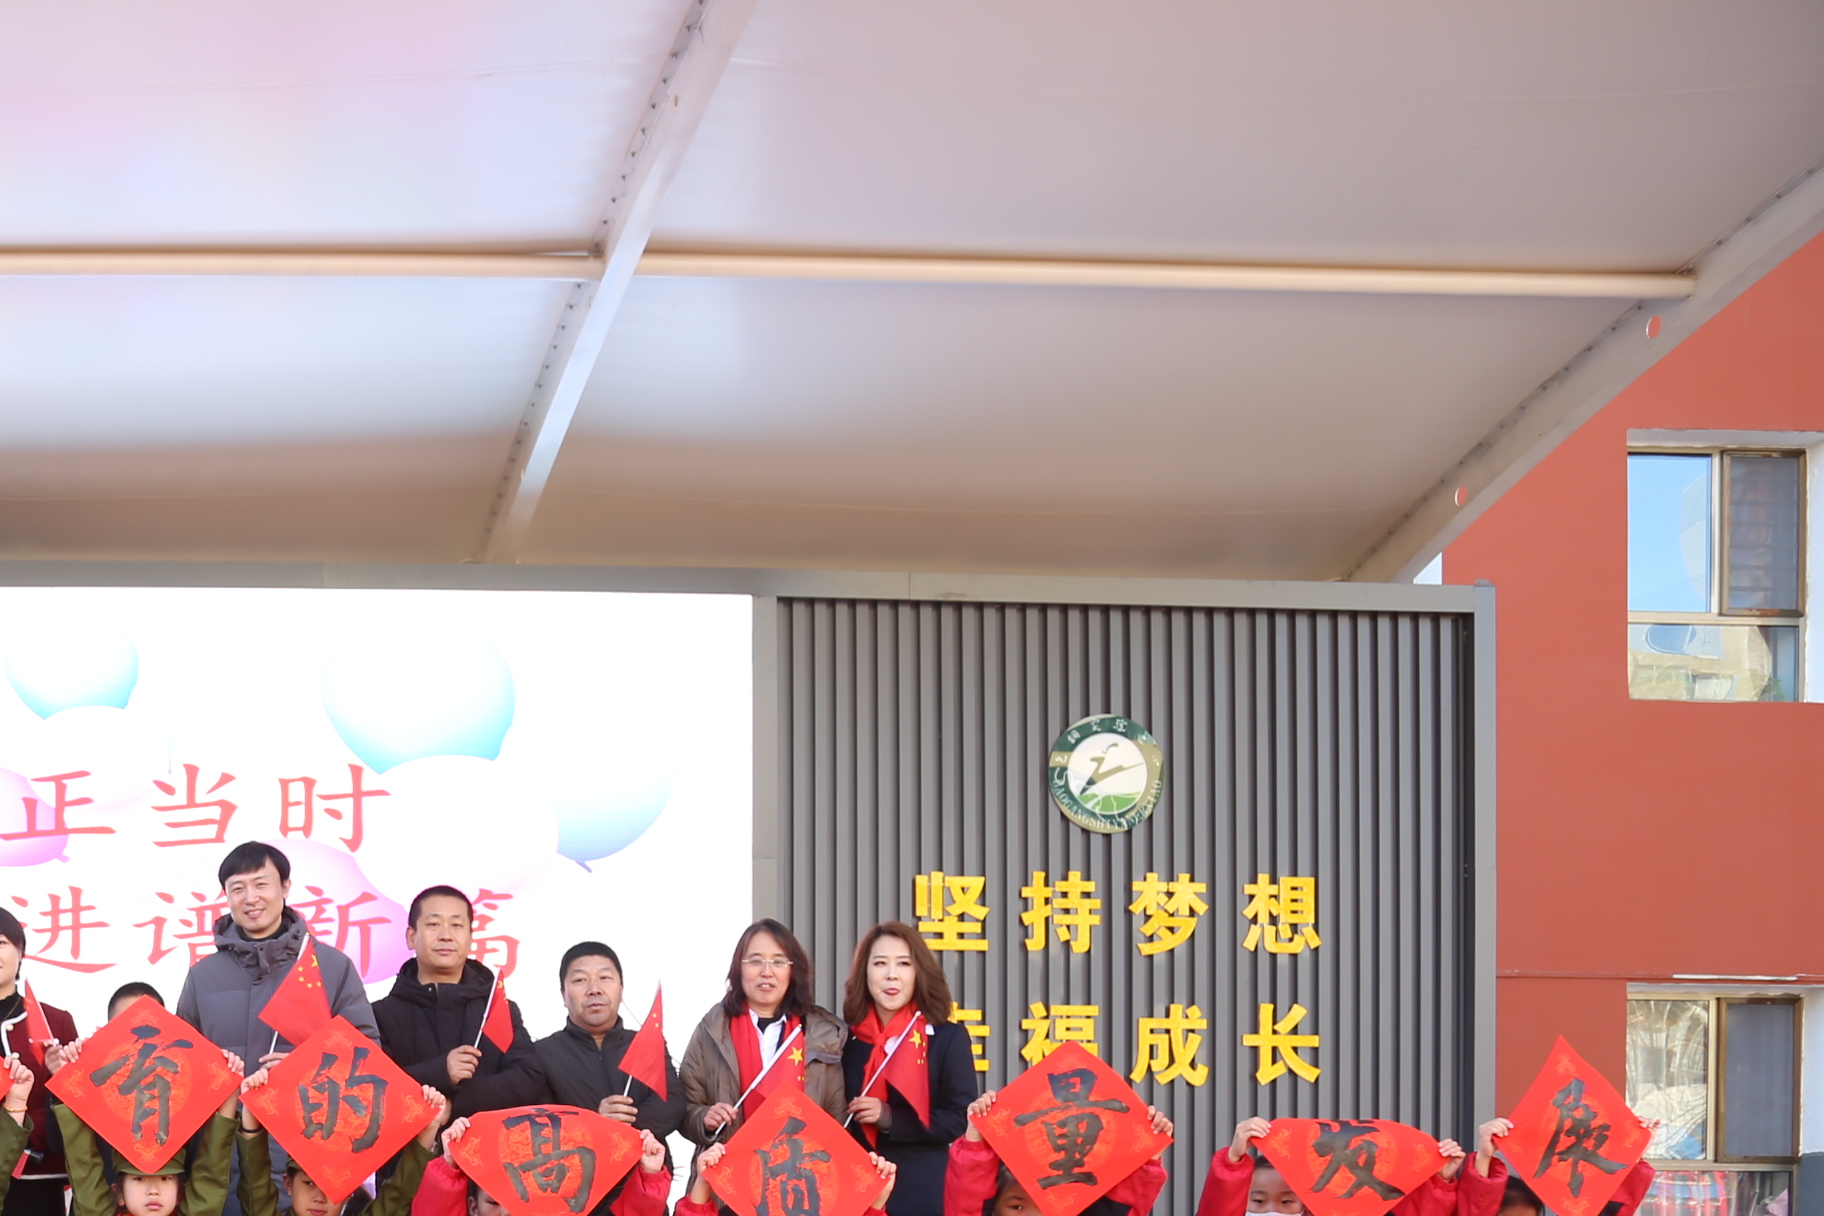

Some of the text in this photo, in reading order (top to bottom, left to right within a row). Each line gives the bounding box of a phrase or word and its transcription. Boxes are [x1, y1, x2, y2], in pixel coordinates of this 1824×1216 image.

[914, 871, 1322, 956] 坚持梦想
[89, 1024, 193, 1146] 育
[297, 1046, 388, 1153] 的
[1013, 1067, 1130, 1190] 量
[1532, 1076, 1629, 1199] 展
[502, 1107, 596, 1215] 高
[1309, 1119, 1407, 1202] 发
